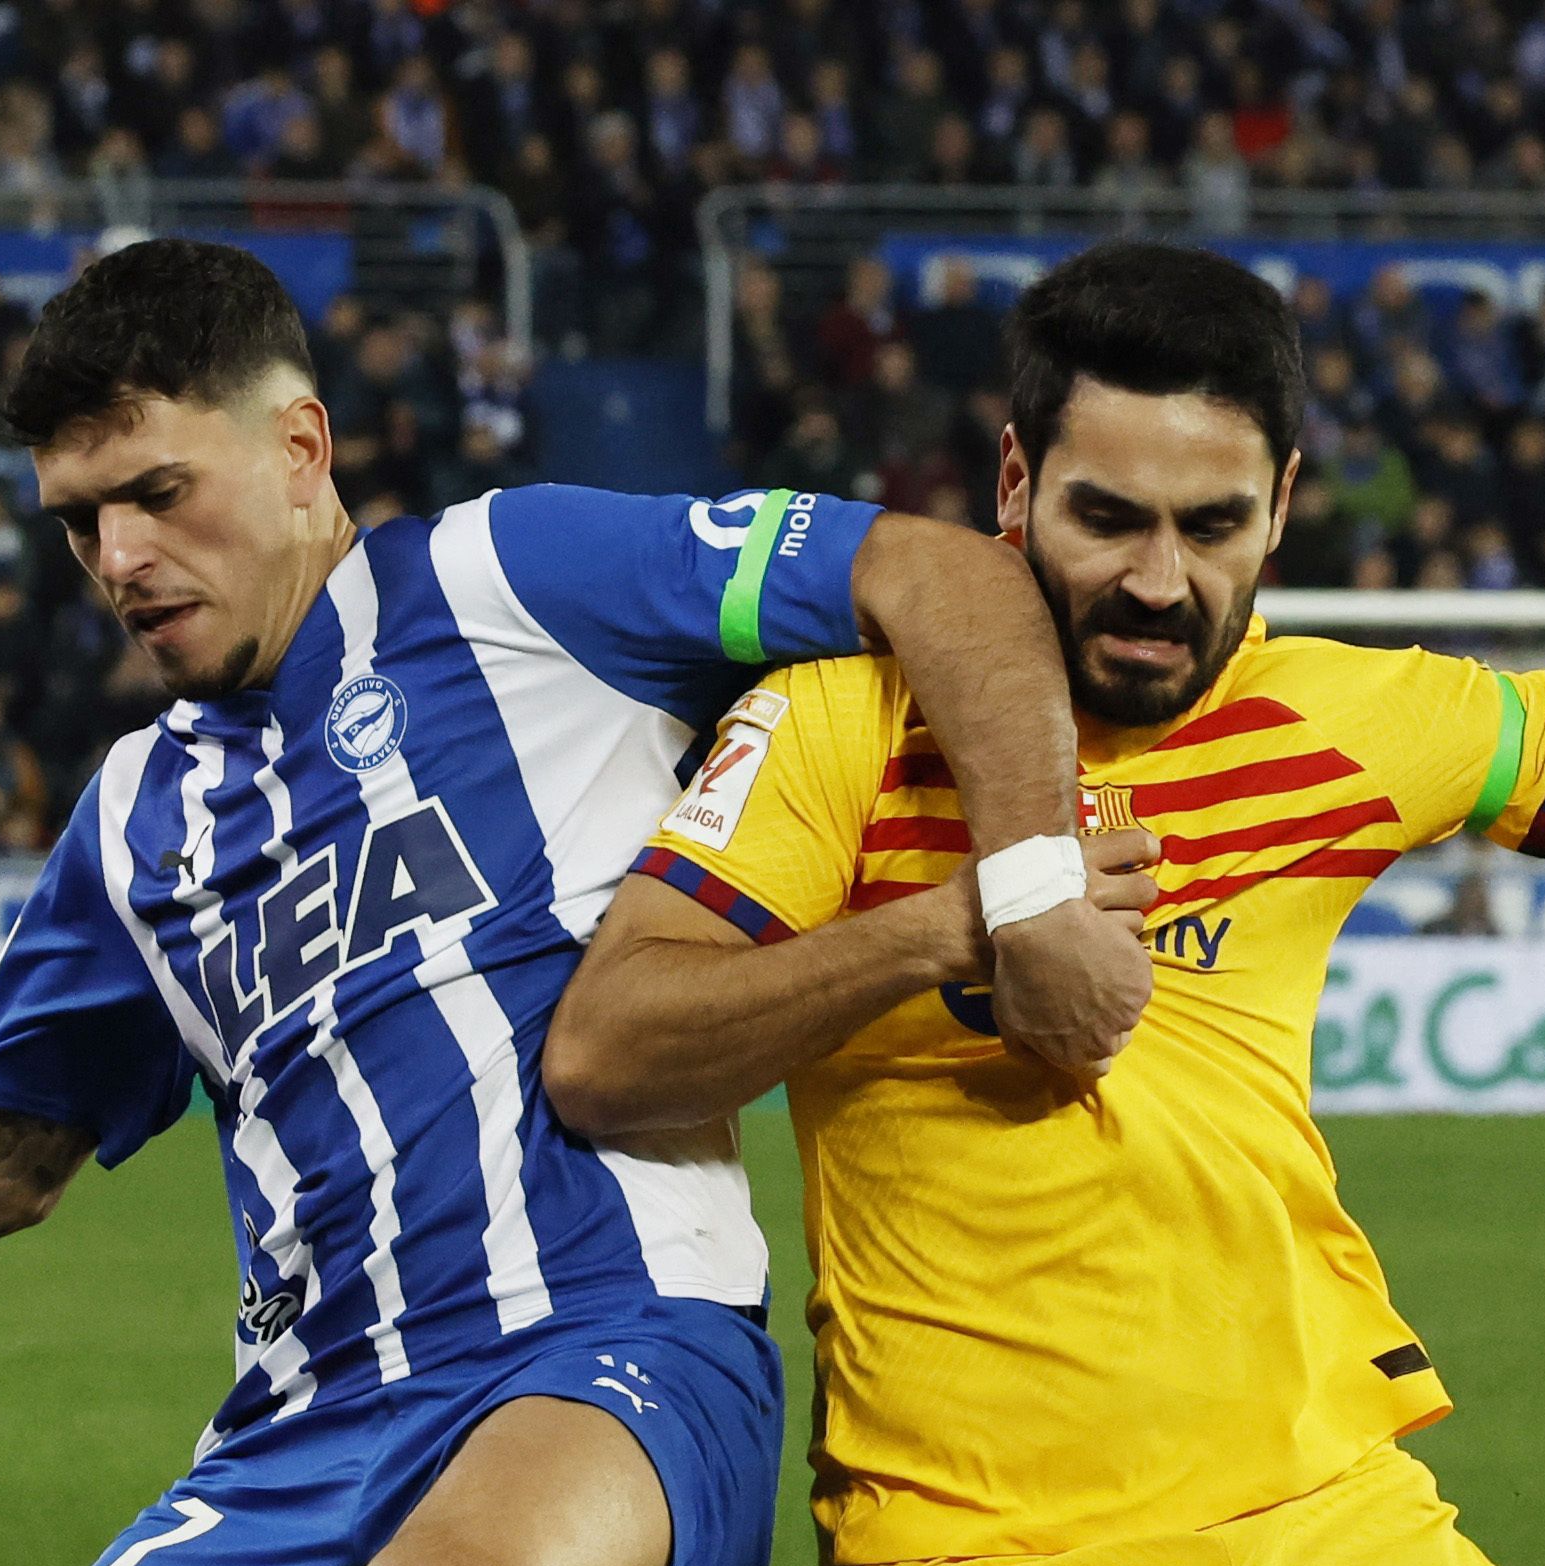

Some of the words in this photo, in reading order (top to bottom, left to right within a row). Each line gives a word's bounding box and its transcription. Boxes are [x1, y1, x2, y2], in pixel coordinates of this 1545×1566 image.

[778, 492, 820, 557] mob
[331, 679, 383, 721] DEPORTIVO
[676, 803, 724, 833] LALIGA
